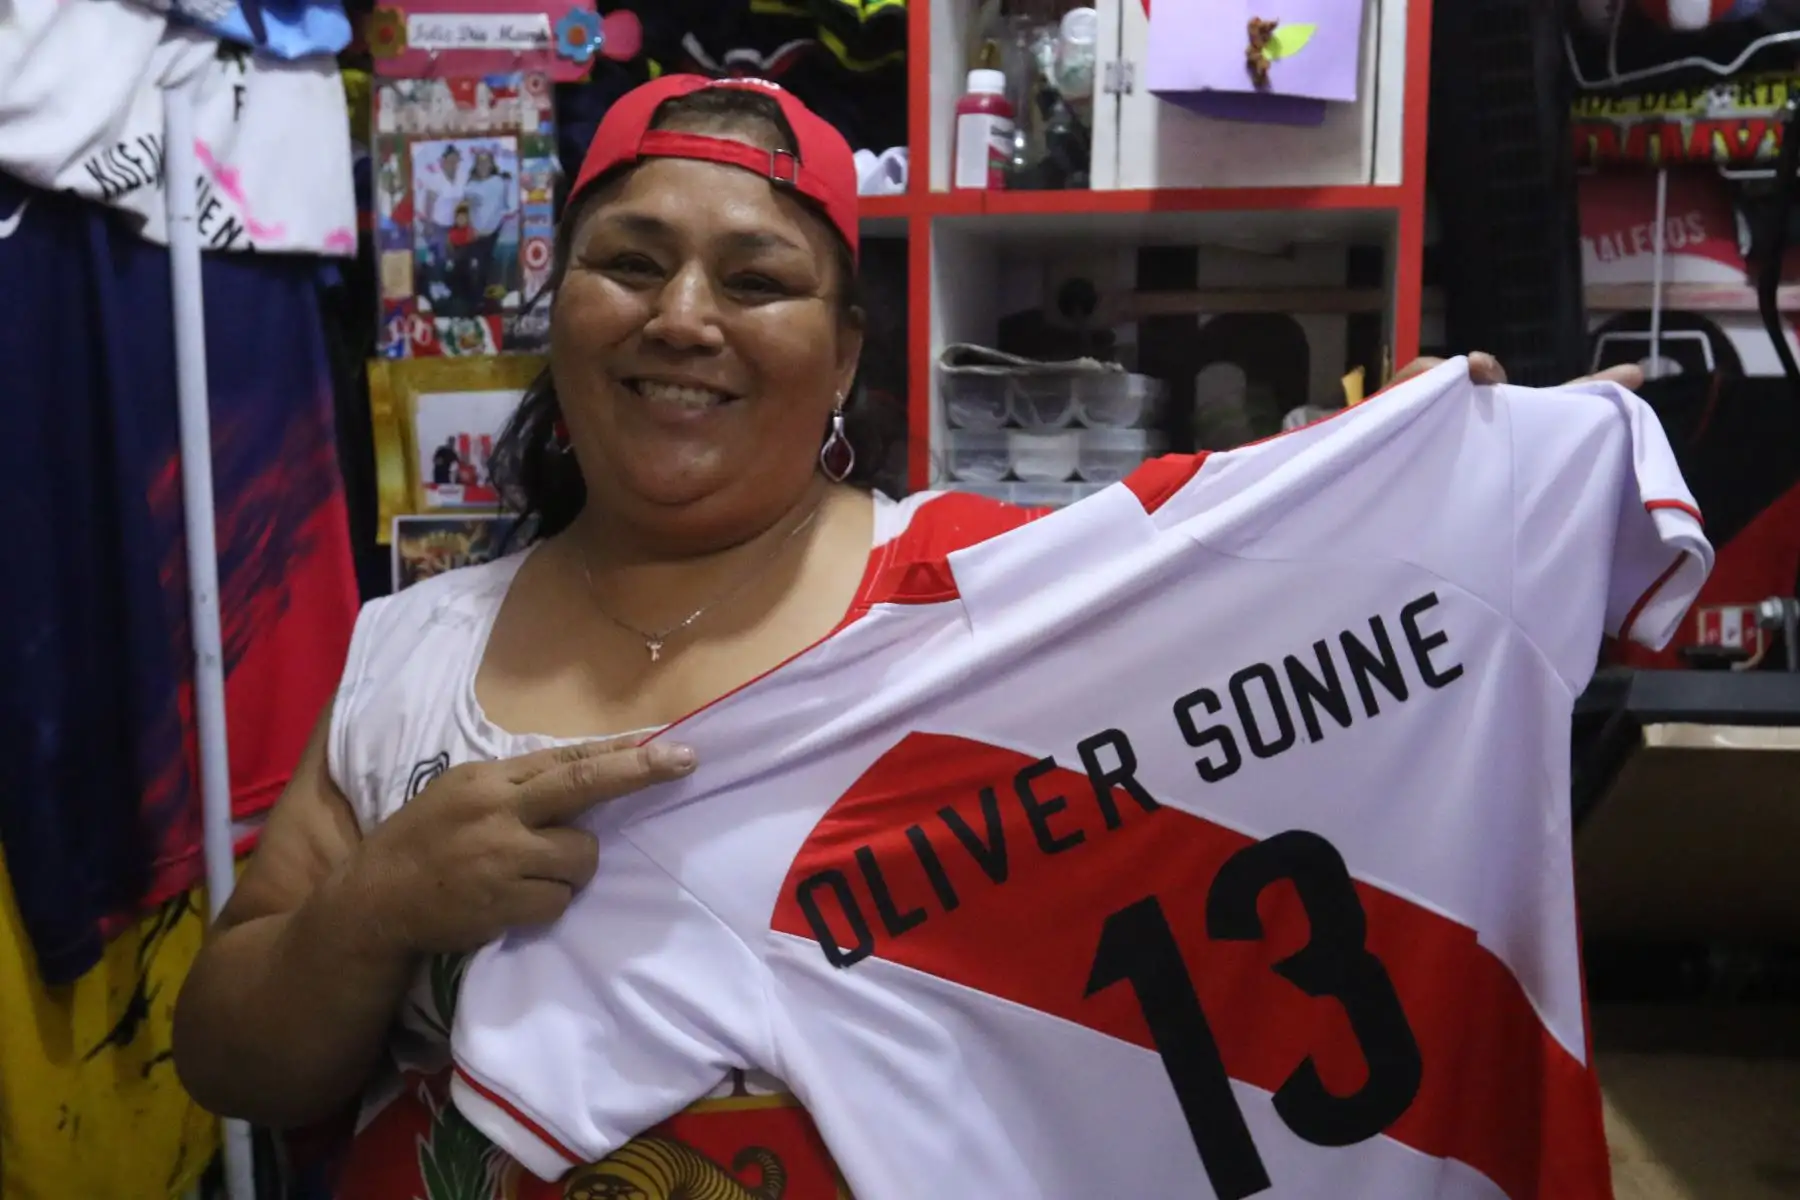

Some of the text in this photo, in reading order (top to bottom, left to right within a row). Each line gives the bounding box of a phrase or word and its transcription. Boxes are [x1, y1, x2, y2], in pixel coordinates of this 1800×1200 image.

[795, 591, 1464, 969] OLIVER SONNE
[1083, 829, 1423, 1200] 13
